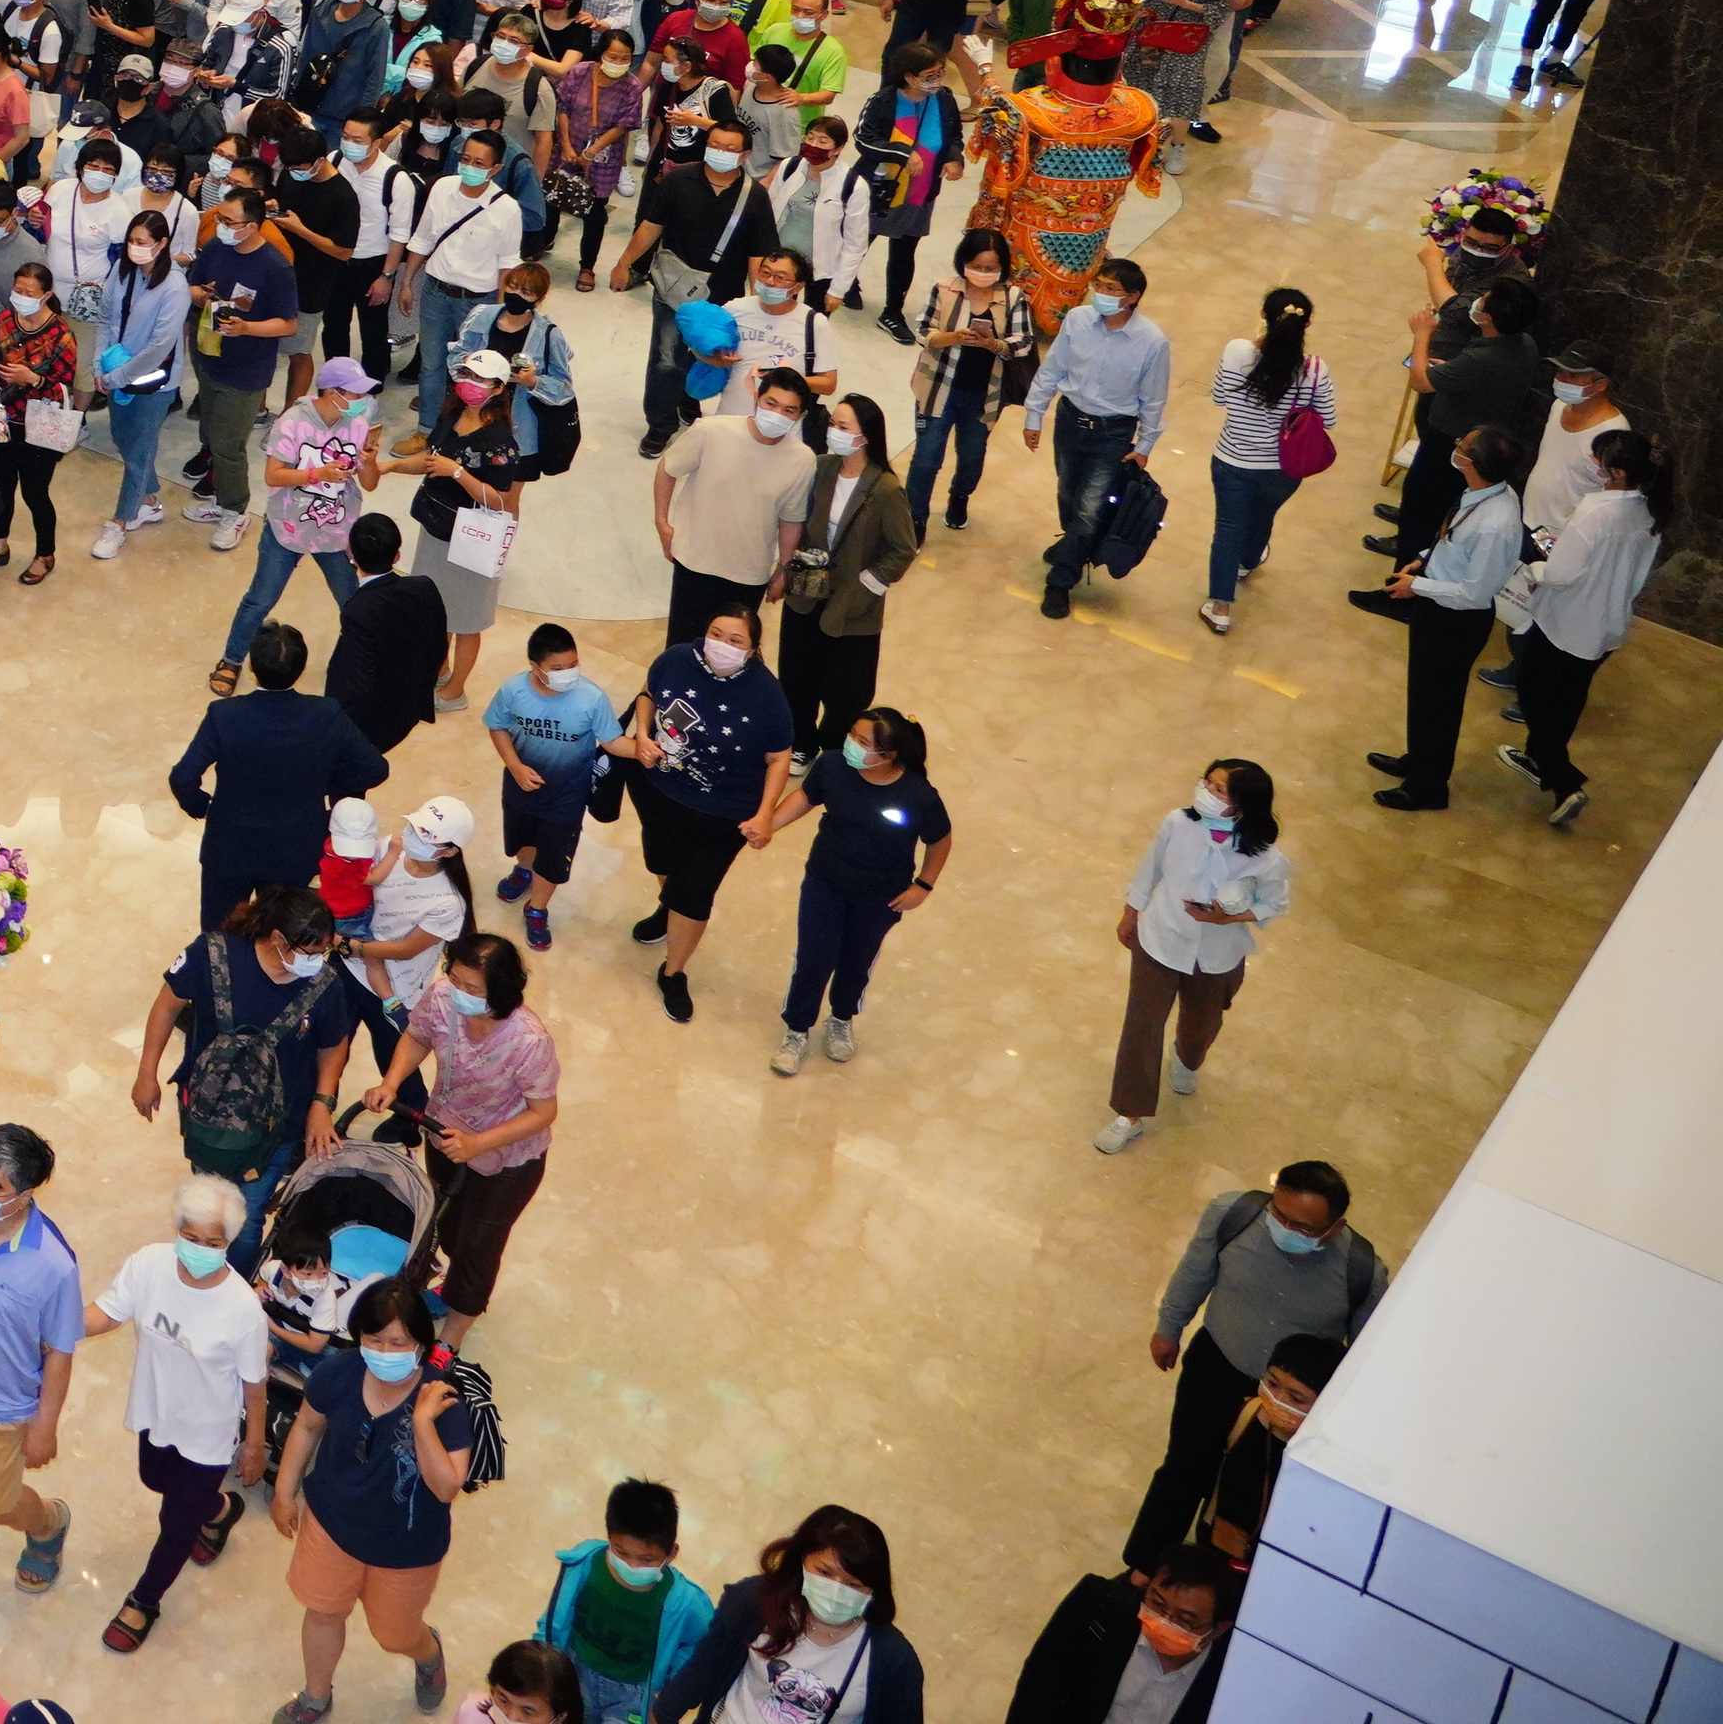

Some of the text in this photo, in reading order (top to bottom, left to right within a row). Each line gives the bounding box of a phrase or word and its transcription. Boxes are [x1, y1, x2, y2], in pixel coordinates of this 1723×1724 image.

[741, 330, 799, 358] LUE JAYS
[516, 716, 562, 730] SPORT
[428, 805, 444, 821] FILA
